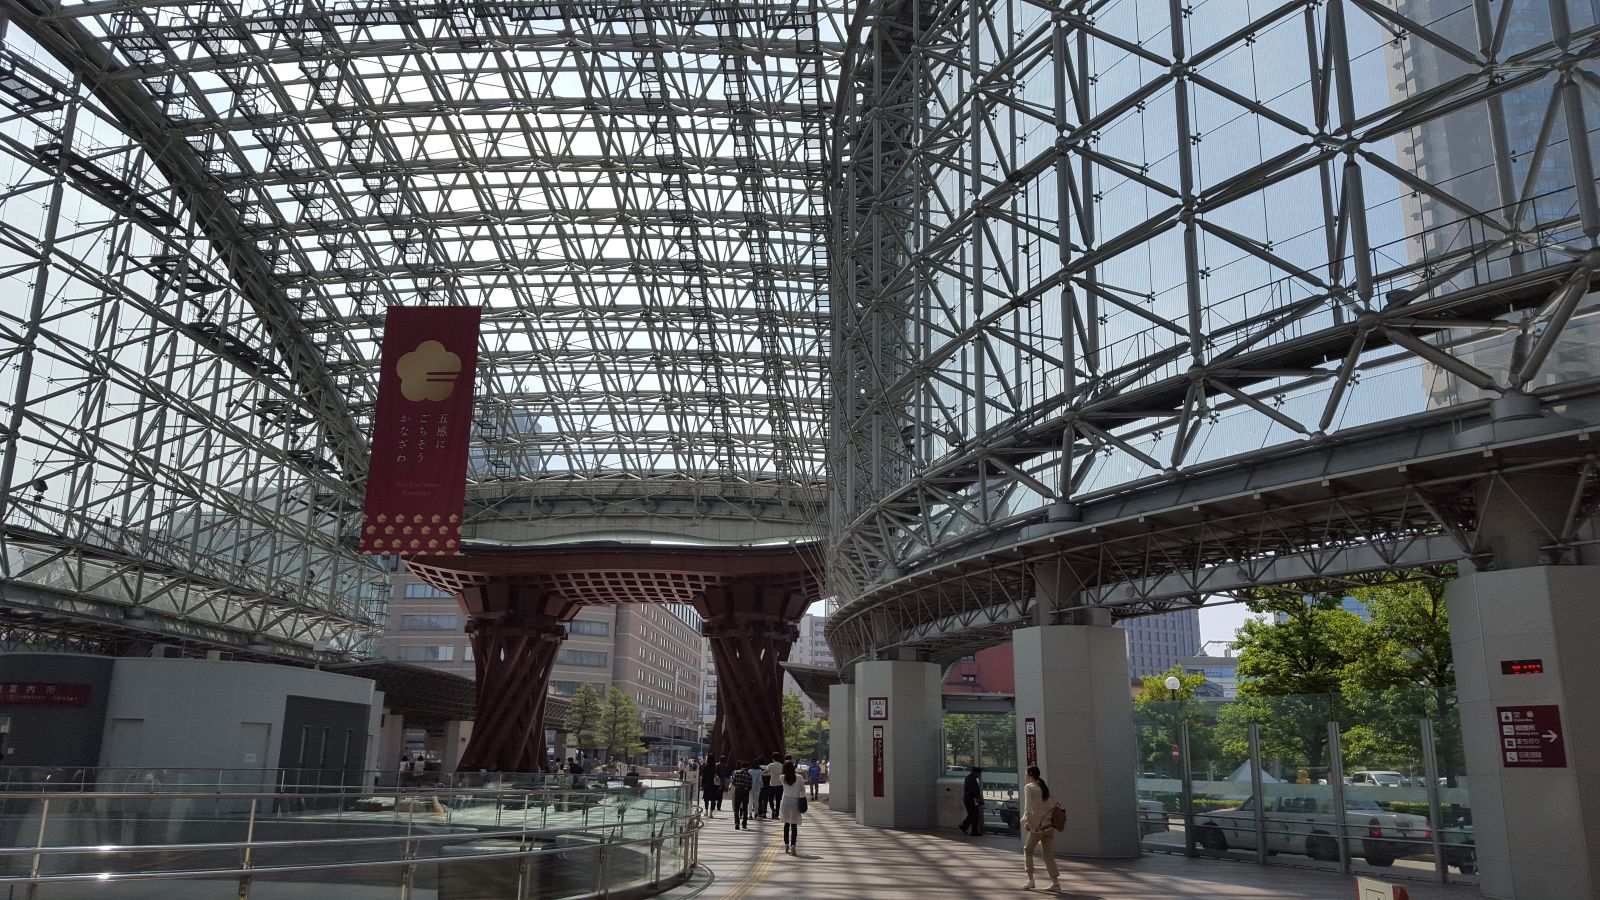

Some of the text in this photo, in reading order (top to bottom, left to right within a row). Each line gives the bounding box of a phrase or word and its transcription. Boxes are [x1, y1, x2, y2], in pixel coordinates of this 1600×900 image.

[397, 413, 411, 463] かなざわ
[436, 413, 449, 449] 五感に
